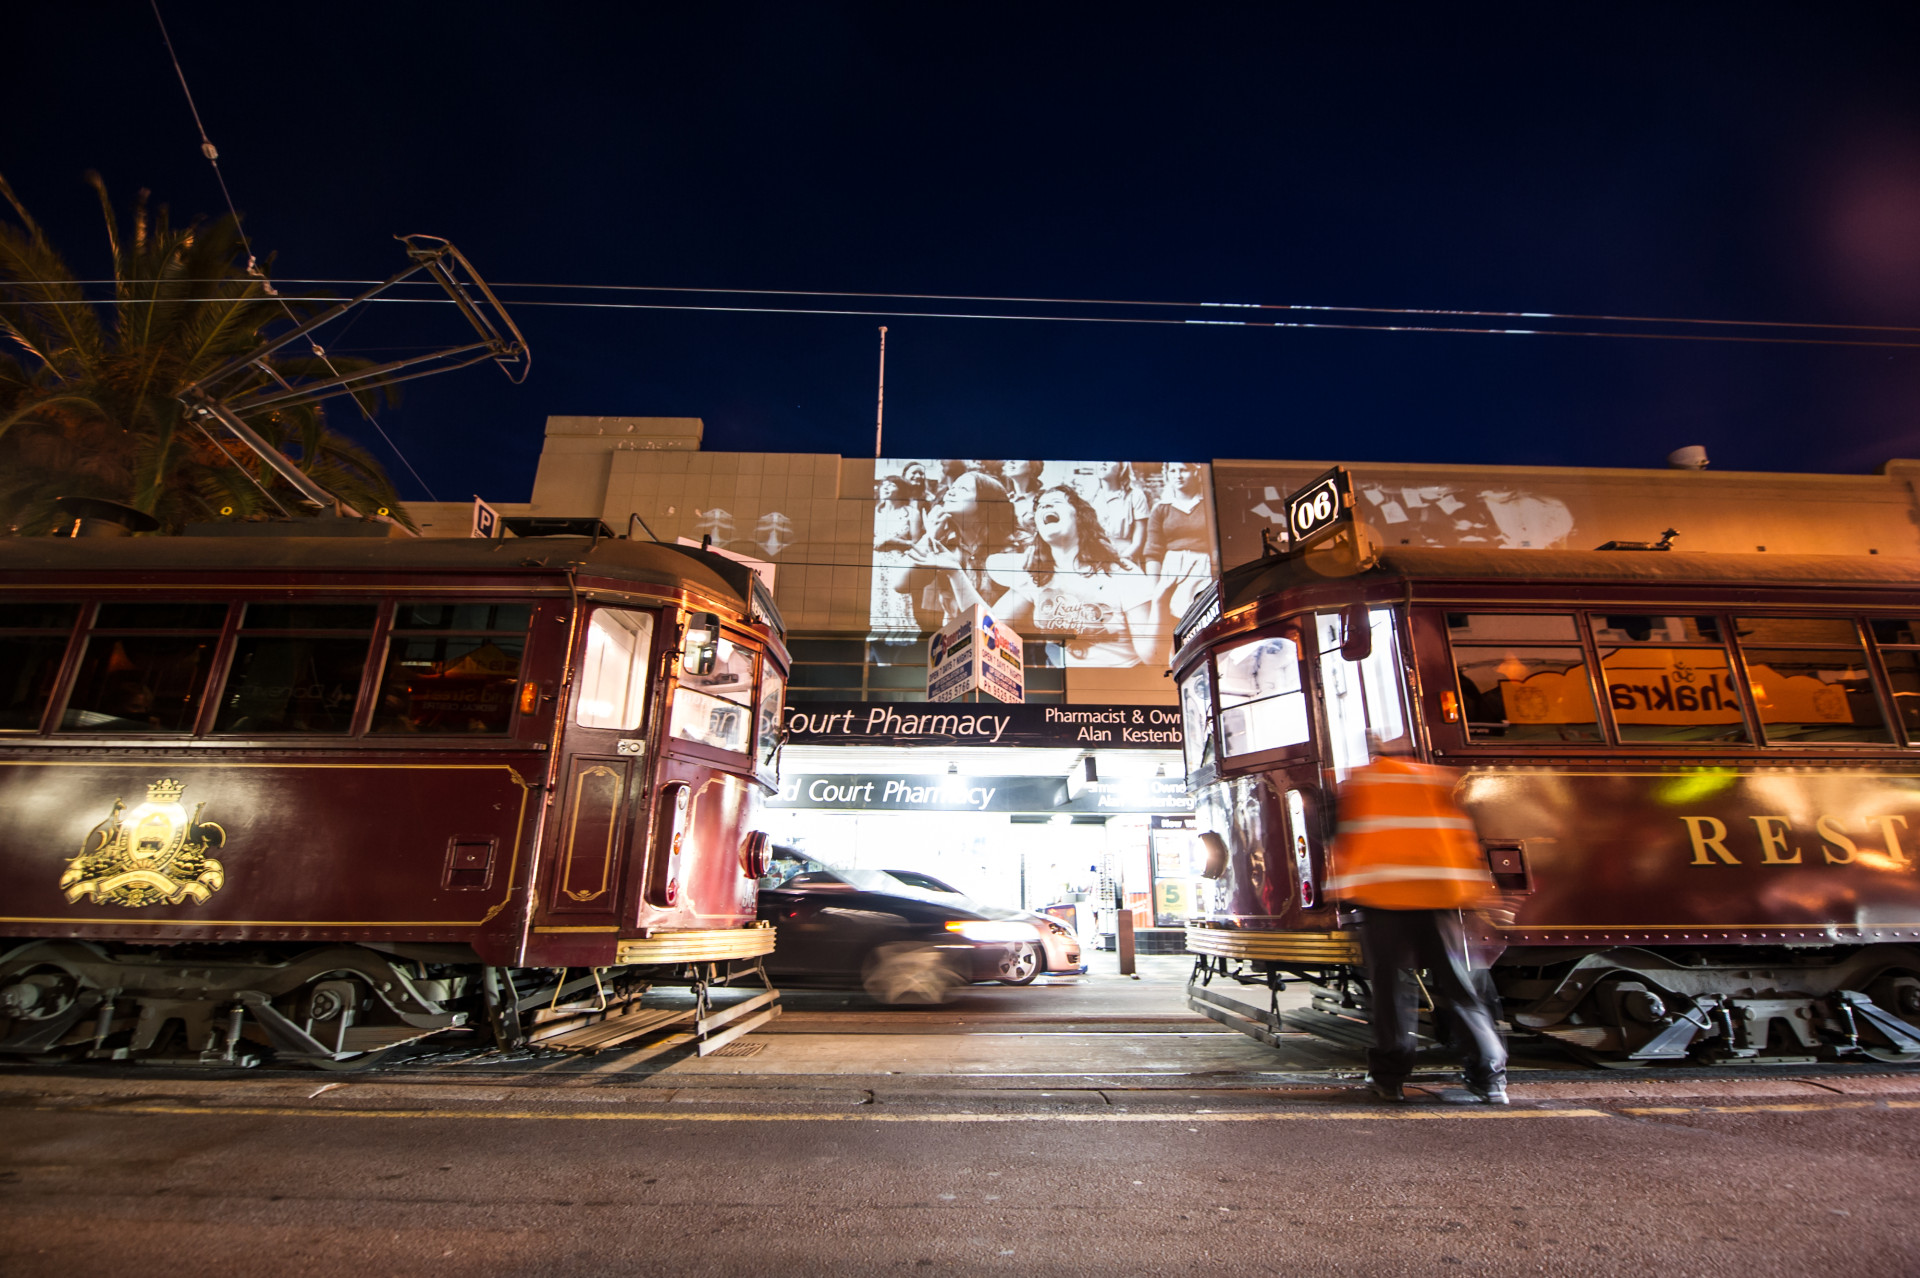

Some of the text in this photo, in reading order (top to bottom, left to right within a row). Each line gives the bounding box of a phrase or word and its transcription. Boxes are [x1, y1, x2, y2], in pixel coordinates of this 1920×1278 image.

[480, 509, 491, 530] P
[1298, 491, 1331, 529] 06
[865, 706, 1010, 743] Pharmacy
[1045, 708, 1126, 724] Pharmacist
[1131, 709, 1145, 724] &
[1077, 726, 1182, 743] Alan Kestenb
[808, 779, 874, 802] Court
[1680, 814, 1909, 865] REST
